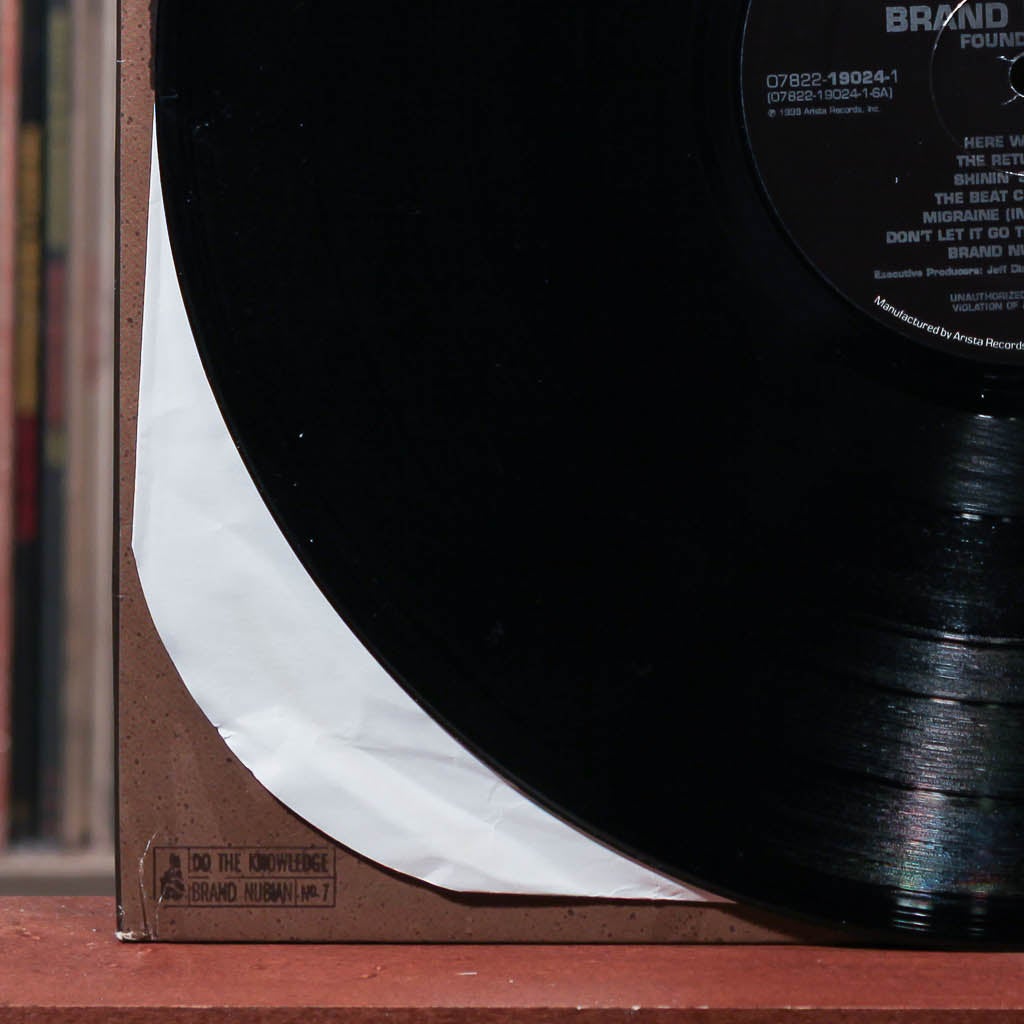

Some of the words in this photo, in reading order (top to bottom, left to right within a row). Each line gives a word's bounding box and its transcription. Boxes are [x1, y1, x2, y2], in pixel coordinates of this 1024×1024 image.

[885, 2, 1009, 32] BRAND
[766, 69, 898, 88] 07822-19024-1
[964, 135, 1004, 149] HERE
[956, 154, 985, 167] THE
[934, 192, 964, 205] THE
[969, 190, 1008, 203] BEAT
[923, 209, 1000, 224] MIGRAINE
[886, 230, 932, 244] DON'T
[938, 228, 964, 241] LET
[969, 228, 983, 240] IT
[988, 226, 1010, 239] GO
[947, 246, 1003, 259] BRAND
[952, 301, 1002, 312] VIOLATION
[1007, 300, 1018, 310] OF
[873, 295, 940, 335] Manufactured
[940, 327, 952, 340] by
[953, 331, 984, 346] Arista
[192, 853, 212, 872] DO
[218, 853, 241, 872] THE
[249, 853, 329, 873] KNOWLEDGE
[192, 882, 237, 902] BRAND
[244, 882, 292, 904] NUBIAN
[322, 883, 330, 902] 7
